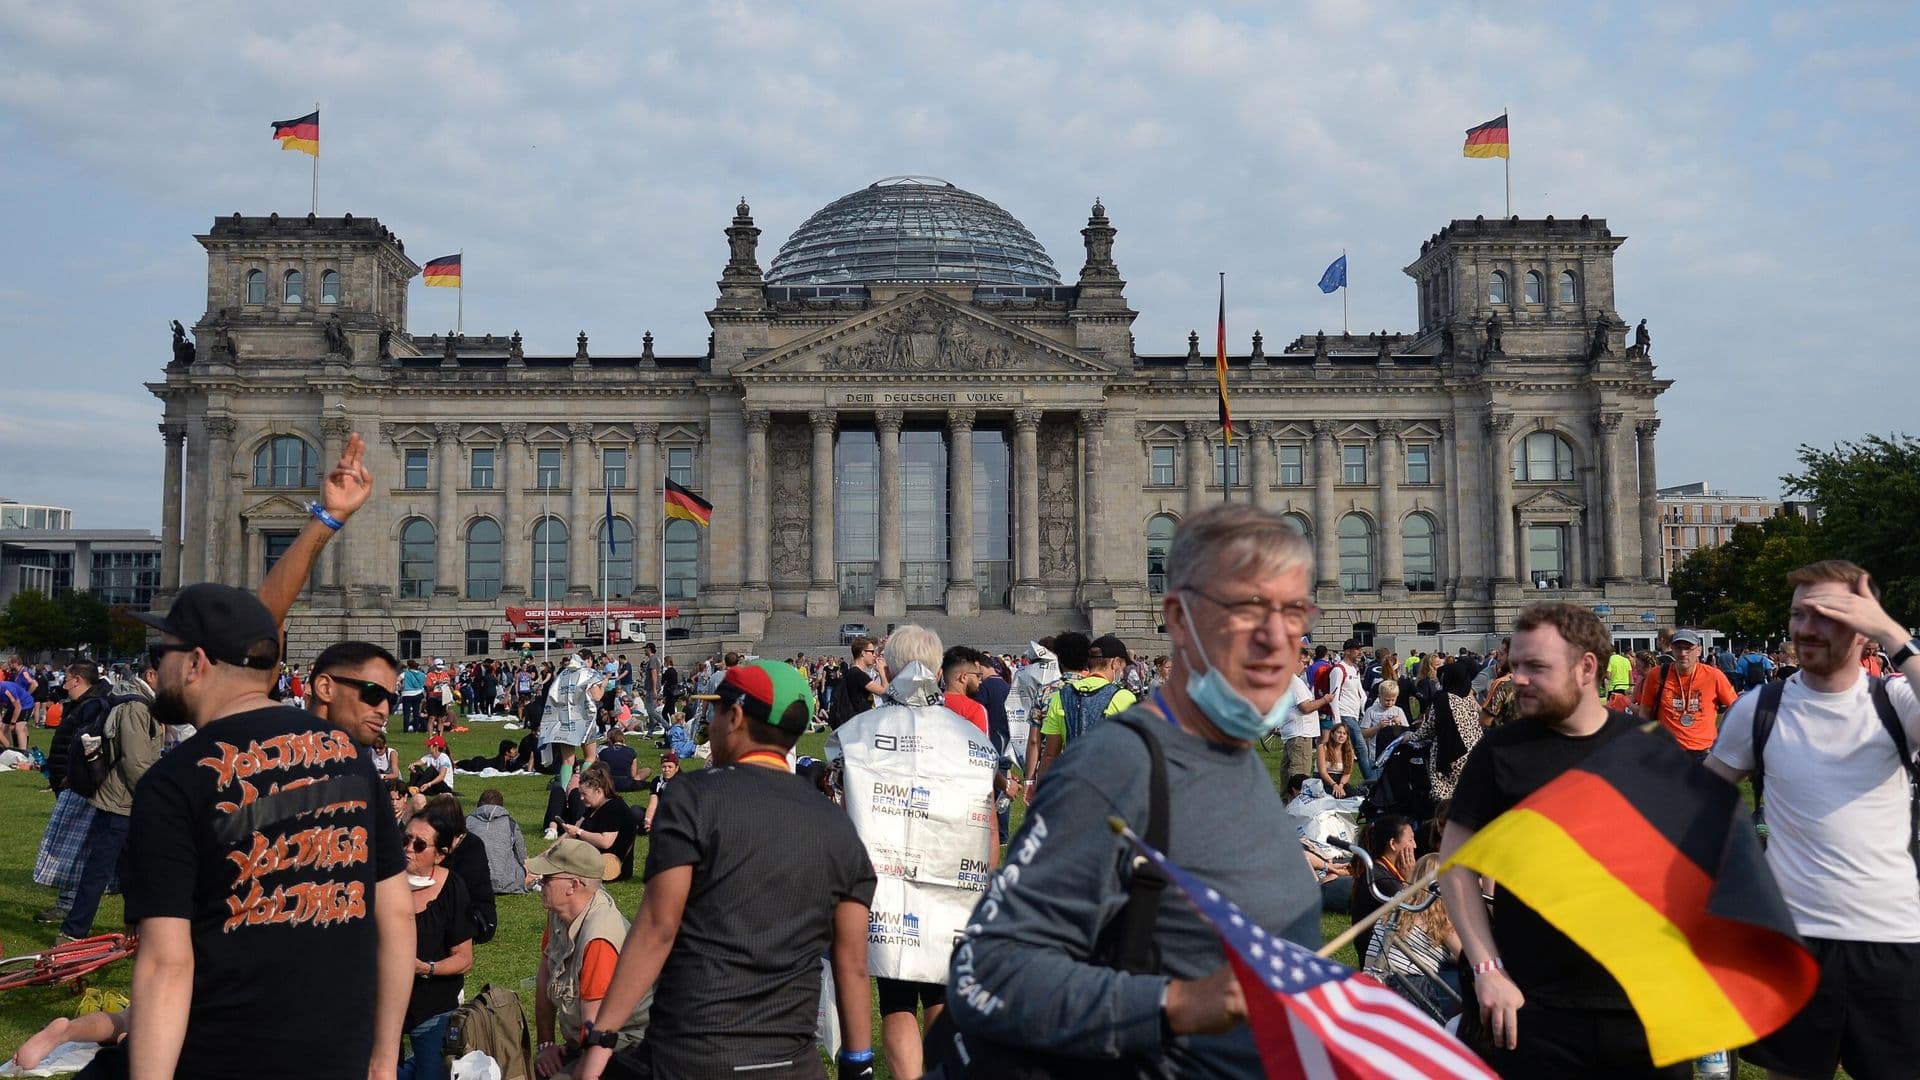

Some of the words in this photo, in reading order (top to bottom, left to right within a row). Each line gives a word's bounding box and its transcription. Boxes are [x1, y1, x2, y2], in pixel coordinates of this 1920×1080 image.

[846, 393, 874, 403] DEM
[884, 393, 956, 403] DEUTSCHEN
[966, 393, 1004, 402] VOLKE
[873, 782, 909, 798] BMW
[872, 795, 909, 808] BERLIN
[871, 804, 929, 820] MARATHON
[960, 858, 990, 874] BMW
[867, 911, 901, 925] BMW
